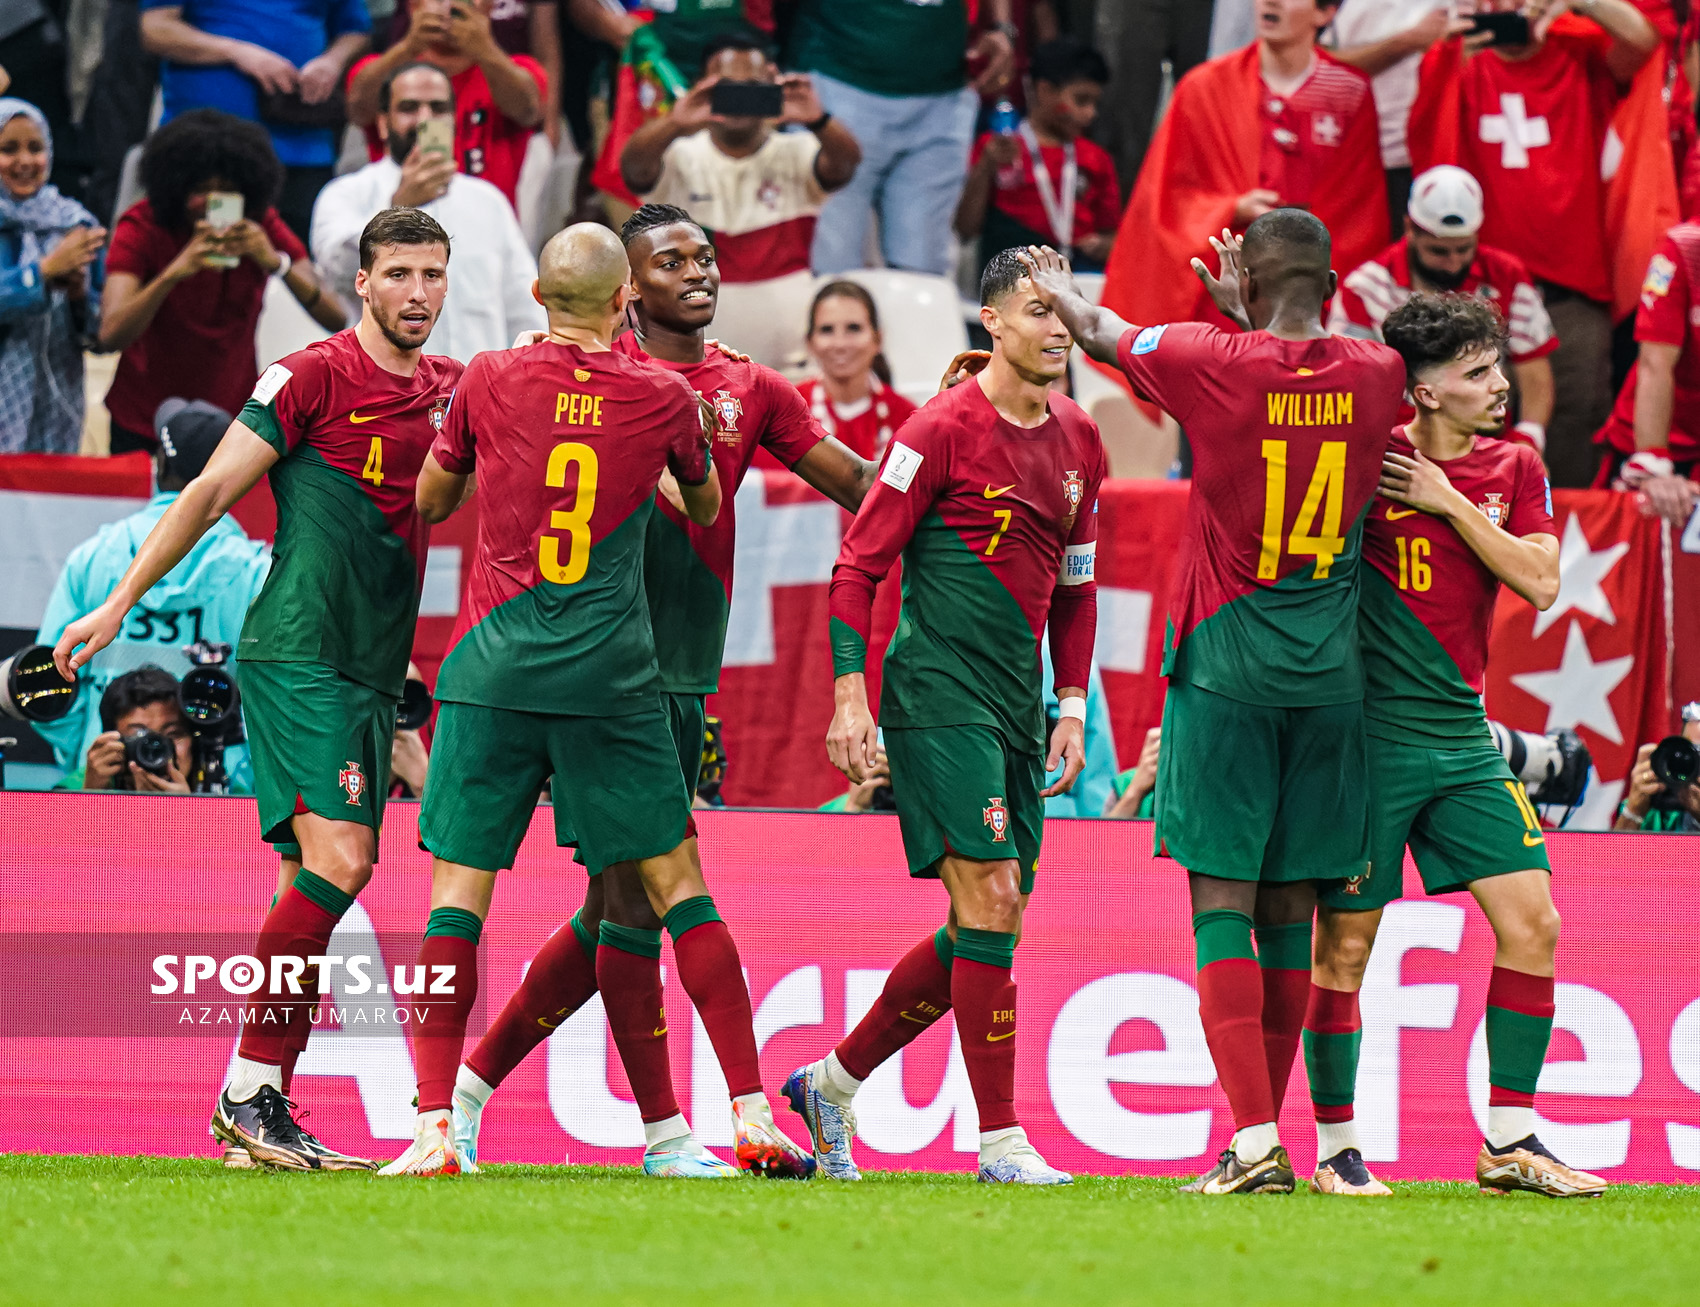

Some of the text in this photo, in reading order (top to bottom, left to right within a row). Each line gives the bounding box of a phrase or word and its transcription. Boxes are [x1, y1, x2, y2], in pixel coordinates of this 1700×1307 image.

[555, 392, 604, 426] PEPE
[1267, 392, 1353, 426] WILLIAM
[363, 437, 384, 487] 4
[538, 442, 599, 585] 3
[985, 509, 1012, 555] 7
[1257, 439, 1347, 580] 14
[1067, 566, 1083, 576] FOR
[1395, 537, 1432, 592] 16
[1356, 900, 1700, 1172] fe
